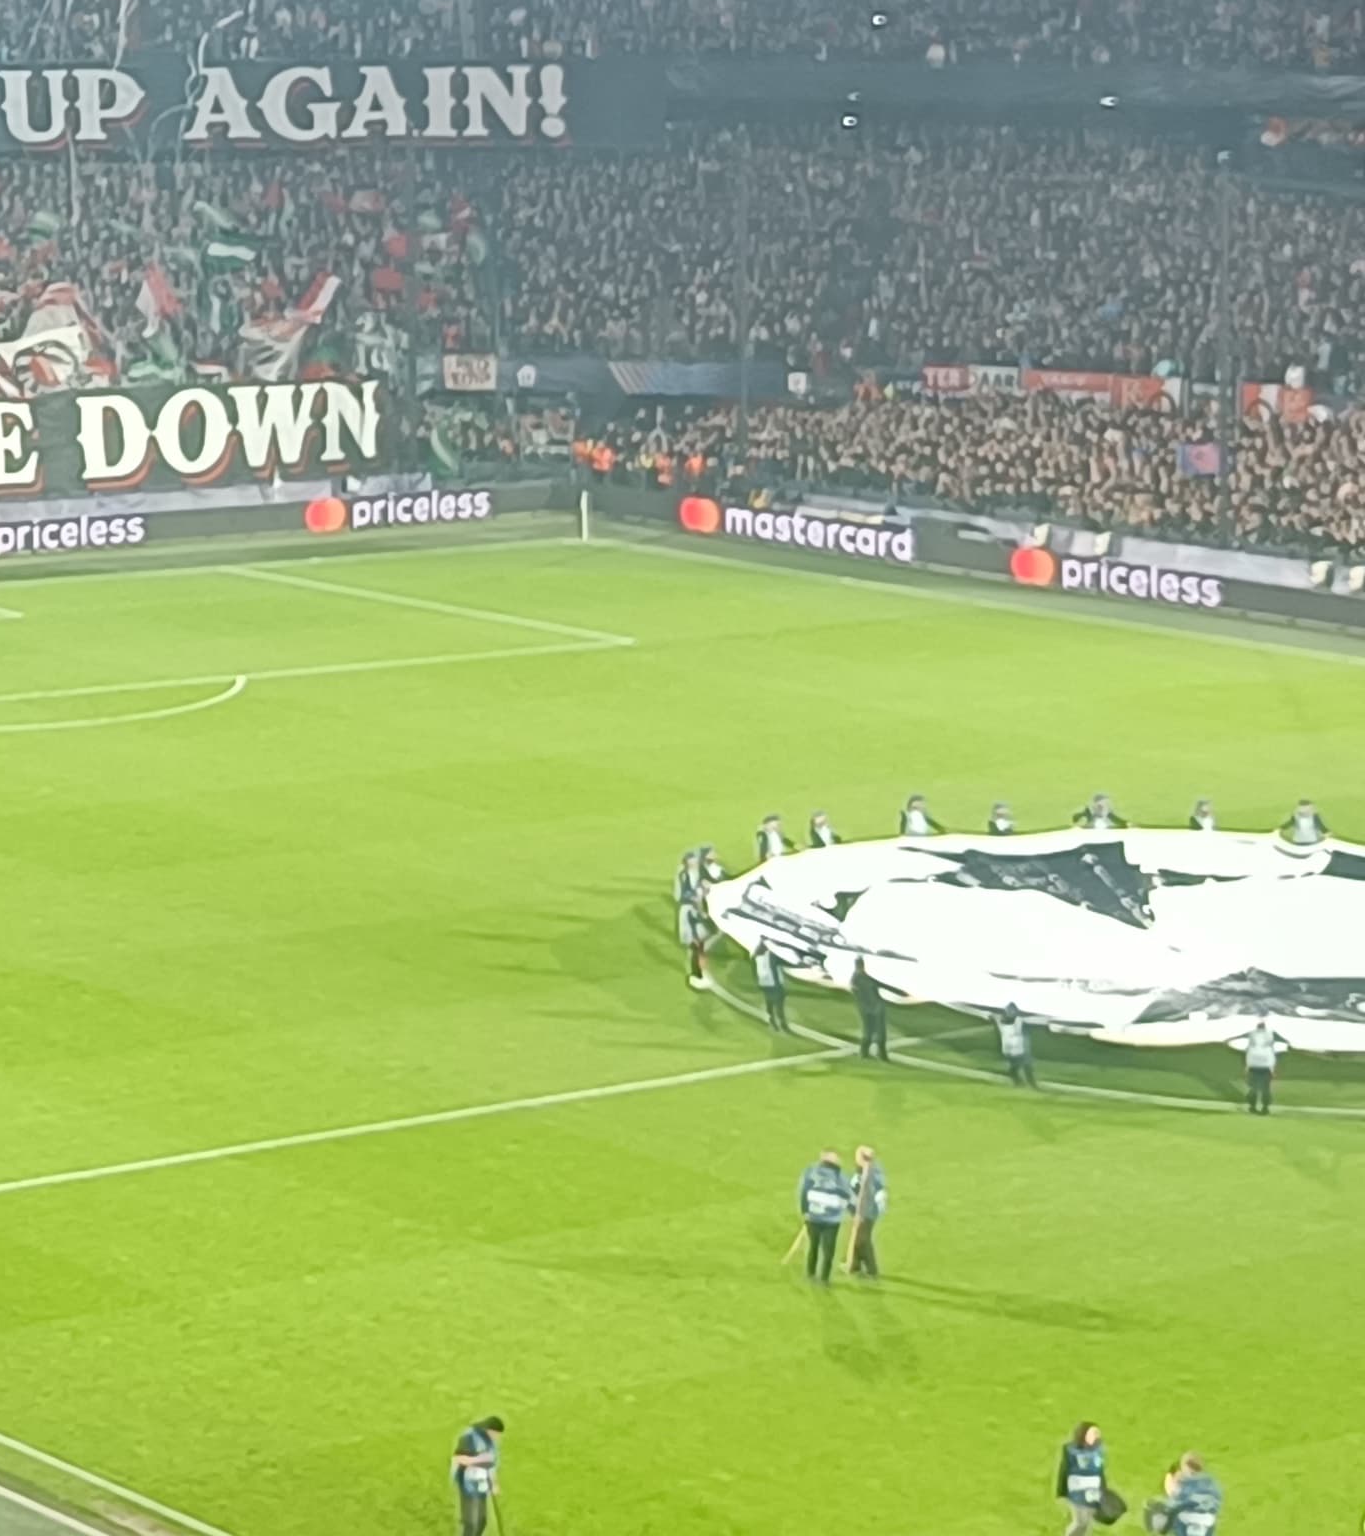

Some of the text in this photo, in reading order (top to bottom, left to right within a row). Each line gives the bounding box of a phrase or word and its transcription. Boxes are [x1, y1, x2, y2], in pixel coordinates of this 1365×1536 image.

[183, 66, 568, 140] AGAIN!
[76, 380, 381, 482] DOWN
[352, 490, 489, 529] priceless
[724, 507, 913, 562] mastercard
[1062, 558, 1222, 607] priceless
